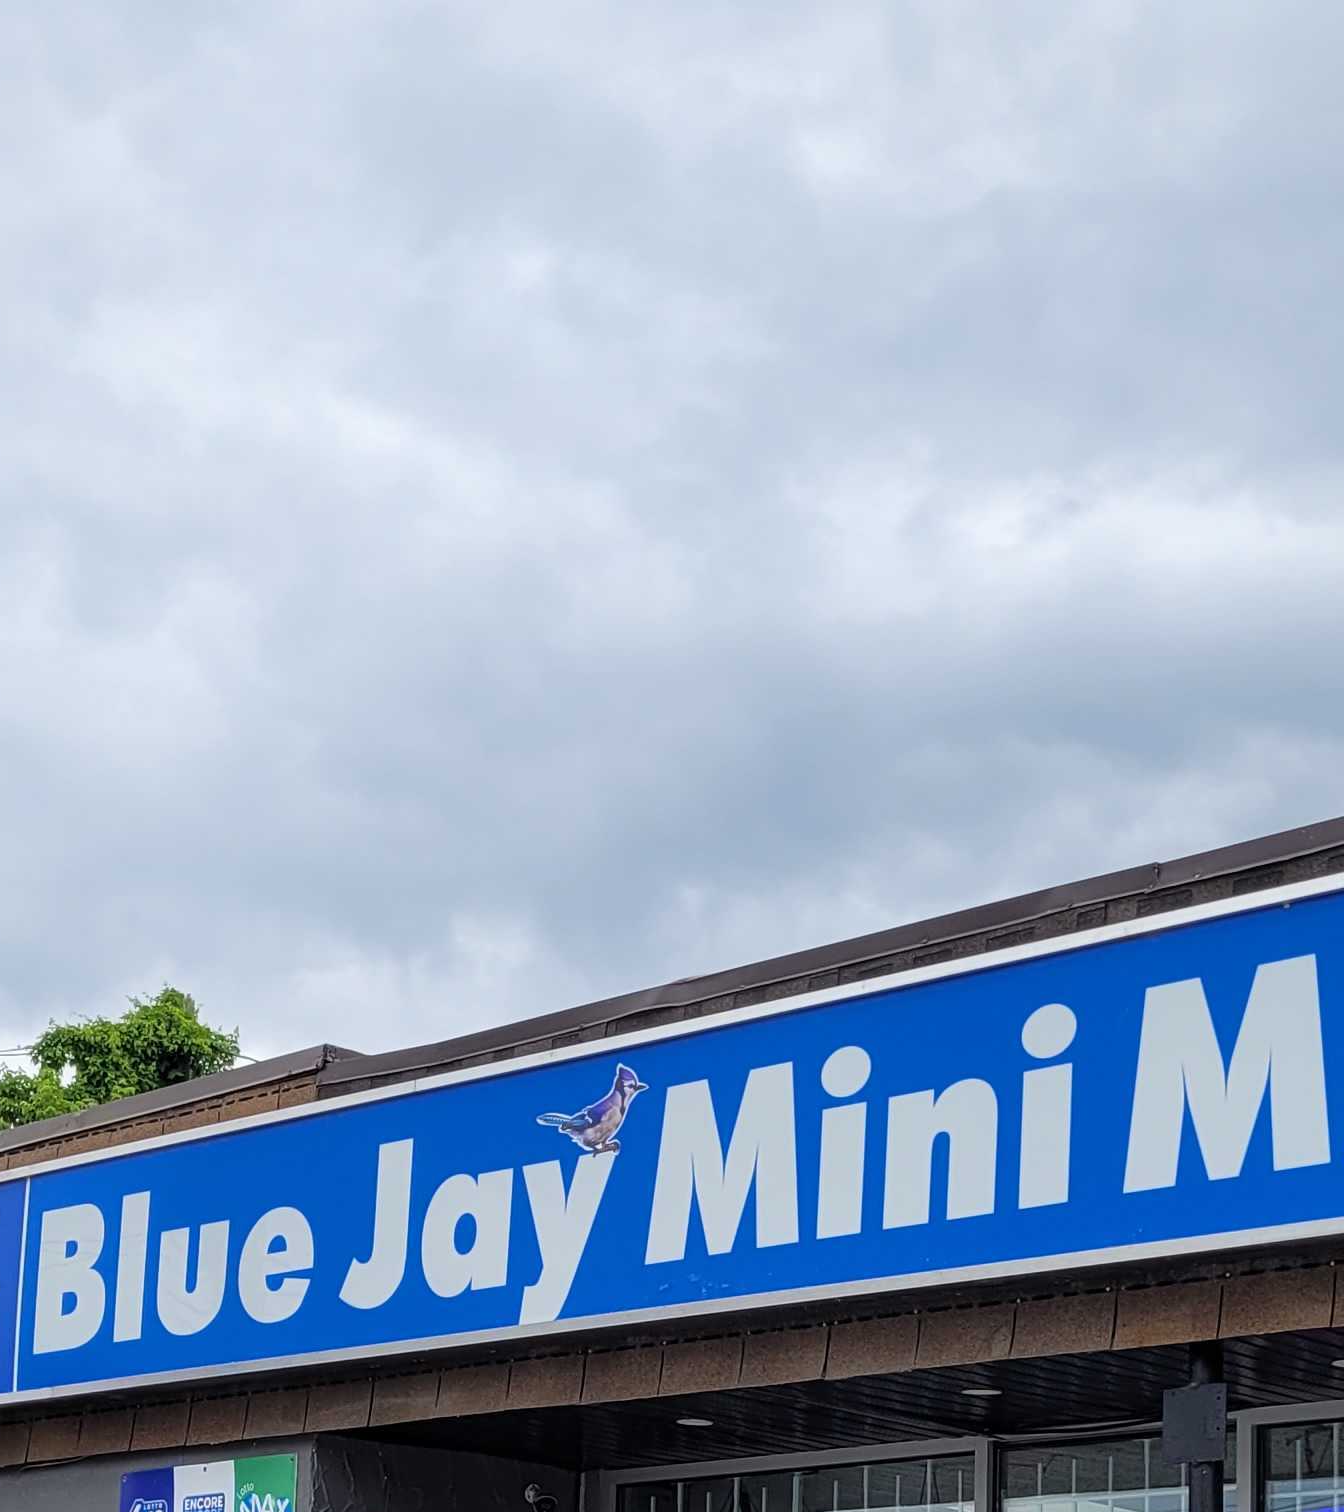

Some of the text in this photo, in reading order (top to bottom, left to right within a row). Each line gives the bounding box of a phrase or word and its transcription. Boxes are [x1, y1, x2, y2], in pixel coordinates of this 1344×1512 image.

[32, 1190, 316, 1355] Blue
[338, 1138, 619, 1326] Jay
[644, 1003, 1078, 1265] Mini
[184, 1495, 224, 1511] ENCORE
